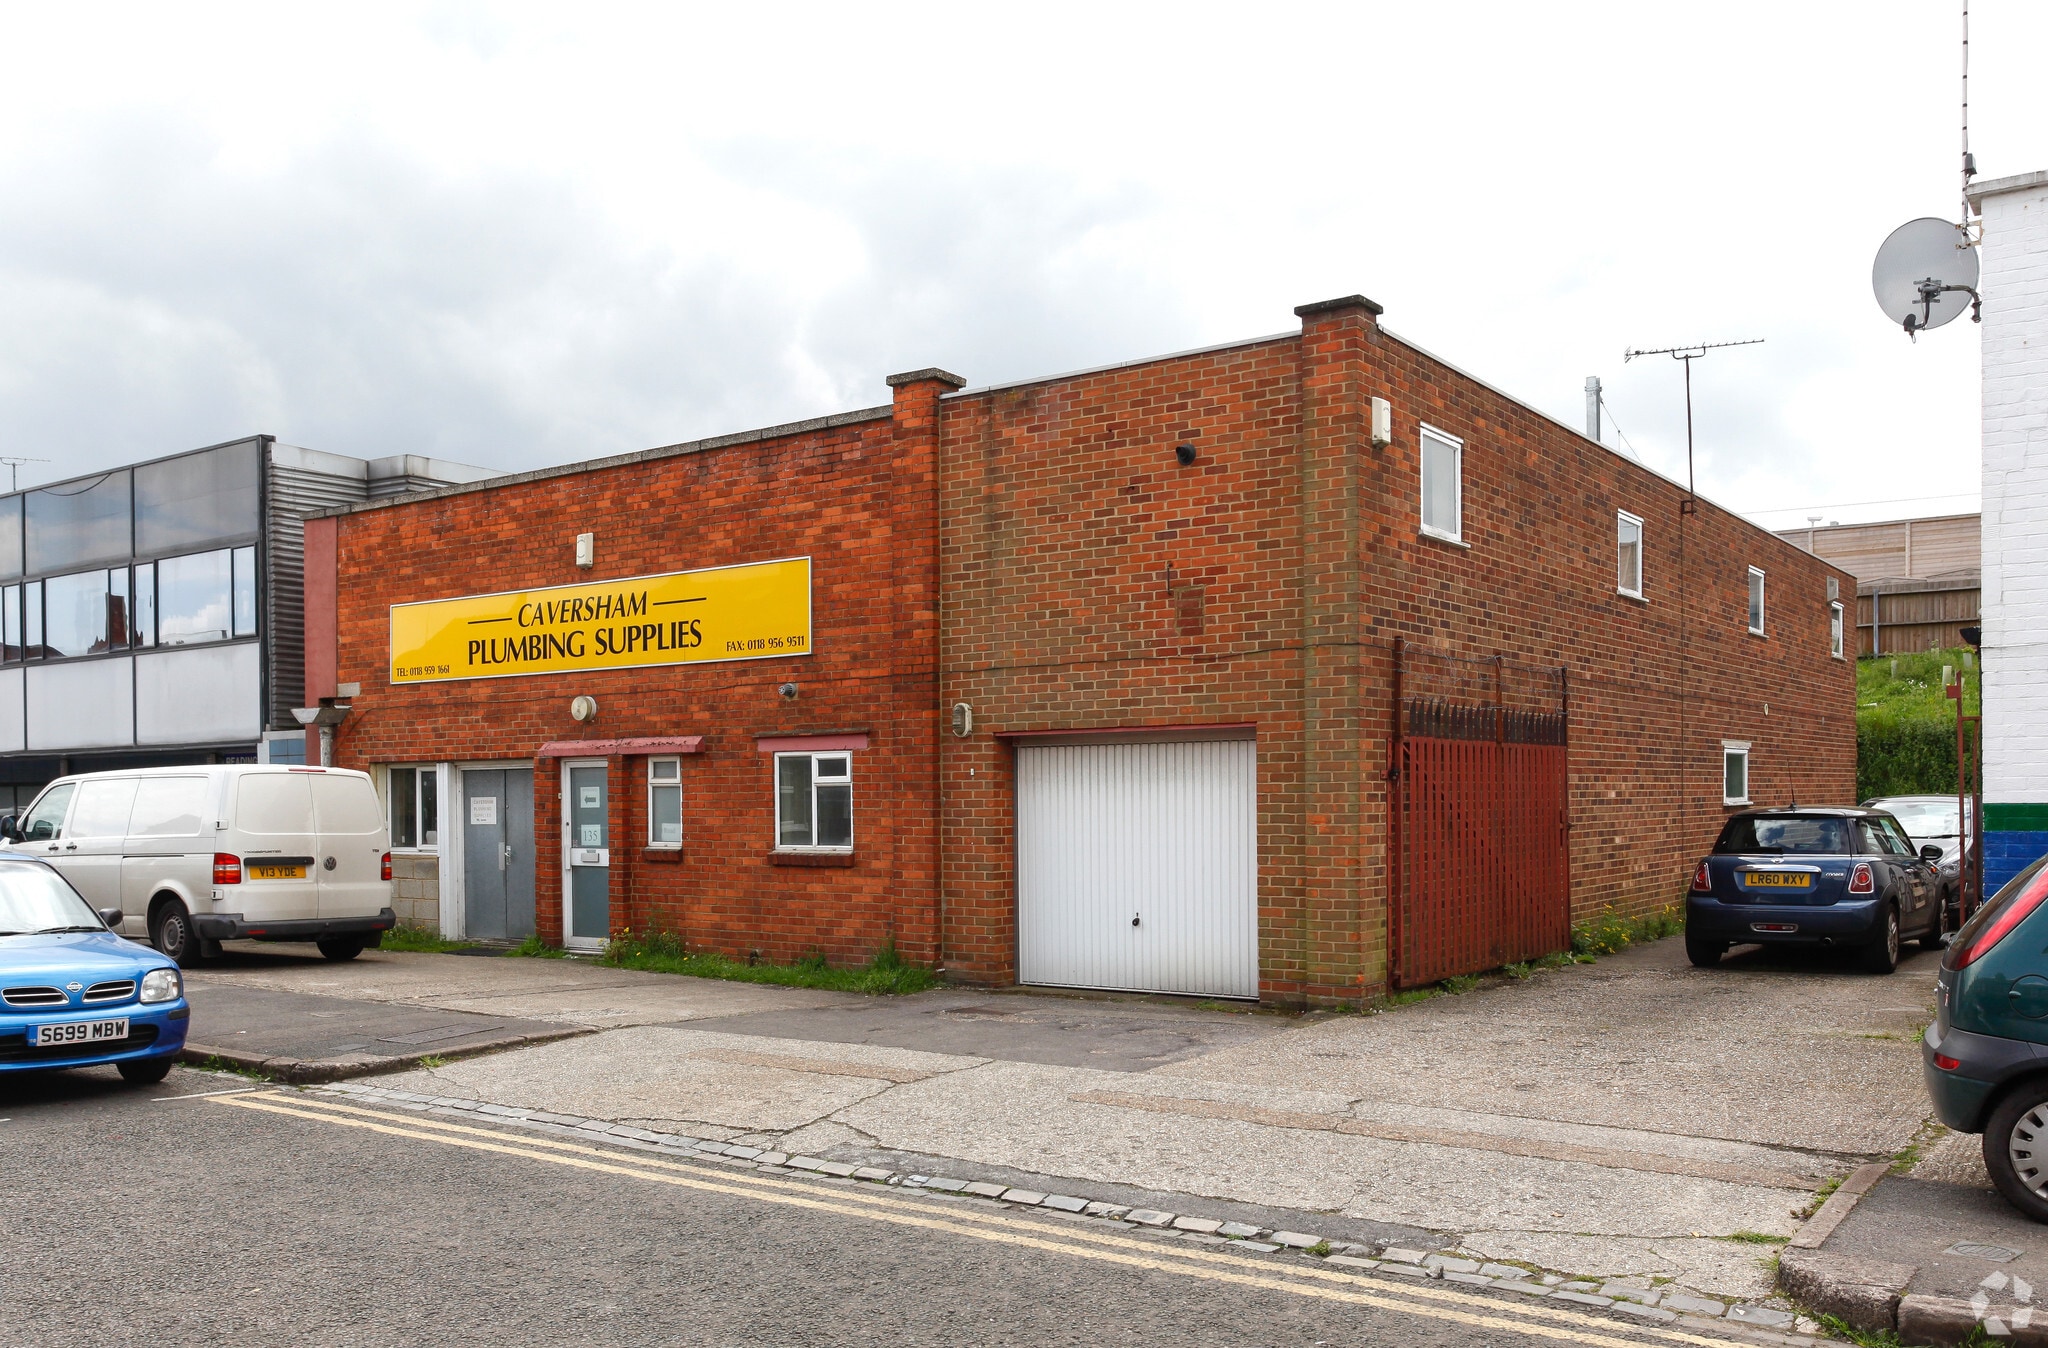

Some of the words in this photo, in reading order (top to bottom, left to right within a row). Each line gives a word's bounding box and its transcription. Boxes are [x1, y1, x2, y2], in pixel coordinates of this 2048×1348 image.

[518, 591, 648, 628] CAVERSHAM
[468, 630, 585, 665] PLUMBING
[595, 619, 702, 656] SUPPLIES
[726, 640, 745, 652] FAX:
[747, 638, 765, 650] 0118
[768, 637, 784, 648] 956
[786, 635, 805, 647] 9511
[396, 667, 408, 677] TEL:
[409, 666, 423, 676] 0118
[424, 665, 436, 675] 959
[437, 664, 450, 674] 1661
[583, 830, 598, 841] 135
[259, 867, 275, 877] V13
[278, 866, 297, 877] YDE
[1750, 873, 1780, 885] LR60
[1782, 873, 1806, 885] WXY
[41, 1024, 88, 1043] S699
[92, 1020, 126, 1038] MBW
